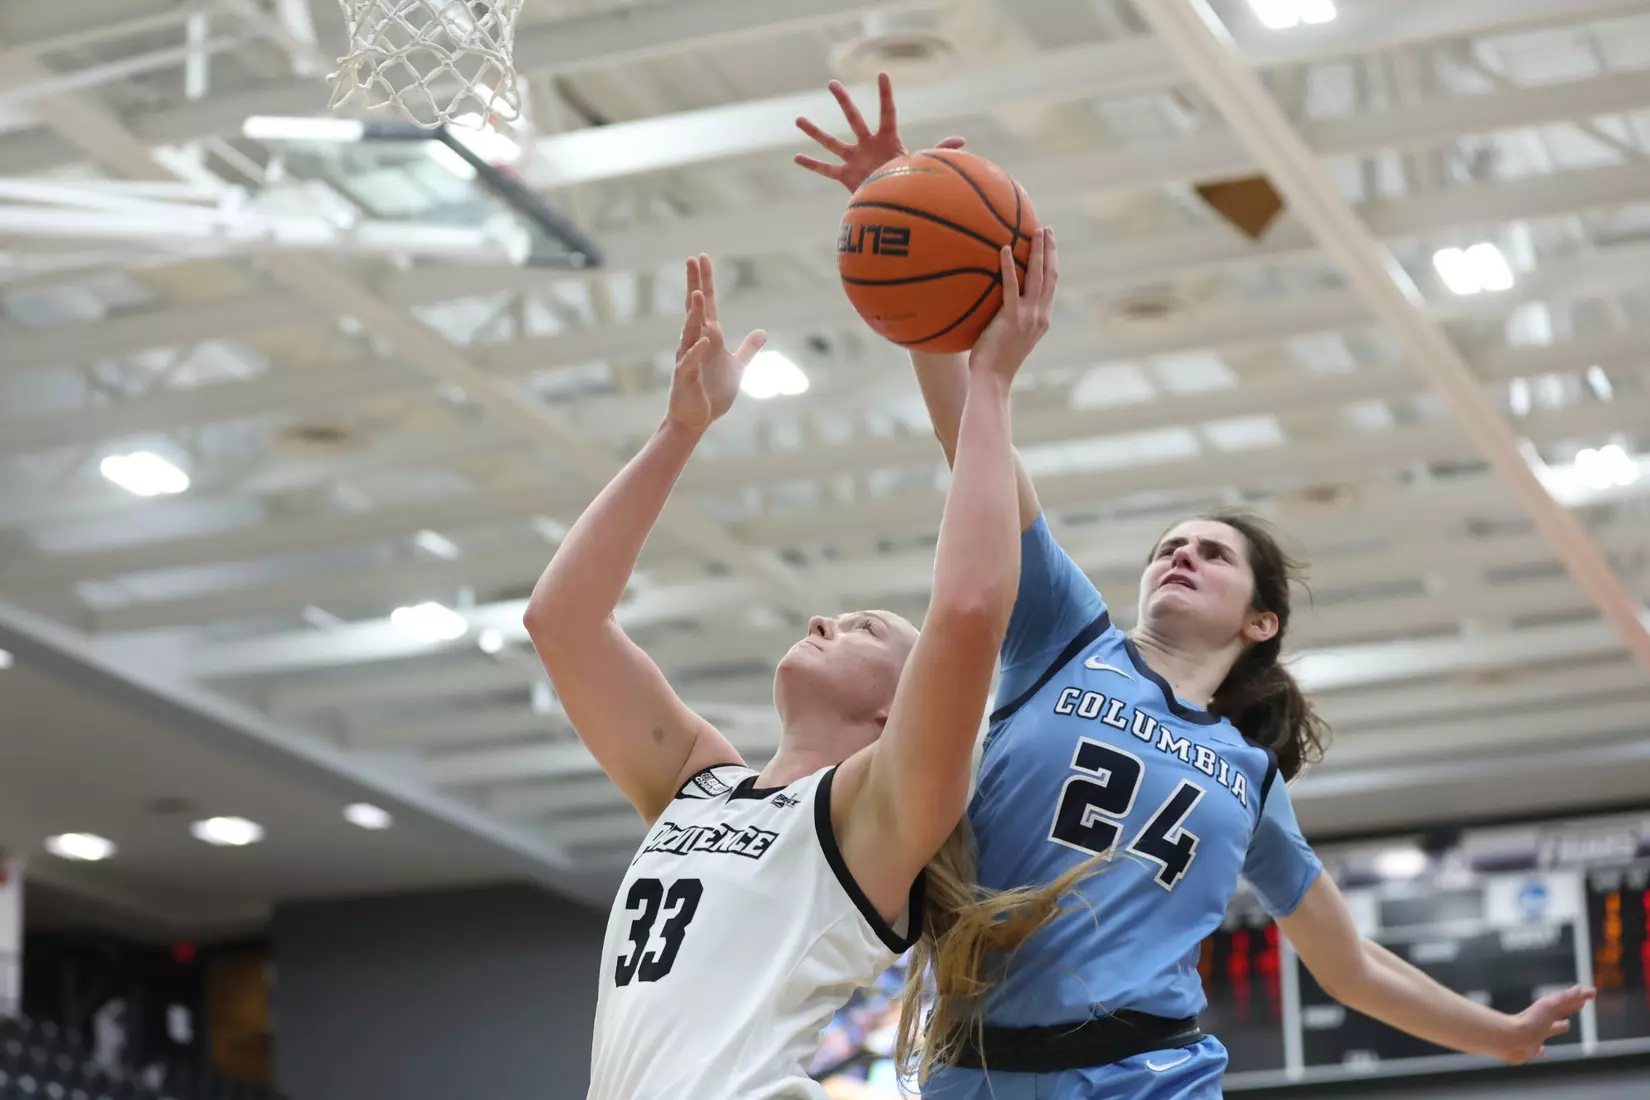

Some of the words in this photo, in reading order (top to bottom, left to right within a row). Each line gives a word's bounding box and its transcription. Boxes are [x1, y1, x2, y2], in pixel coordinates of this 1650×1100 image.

[1053, 687, 1248, 808] COLUMBIA
[1047, 736, 1208, 893] 24
[614, 878, 704, 988] 33
